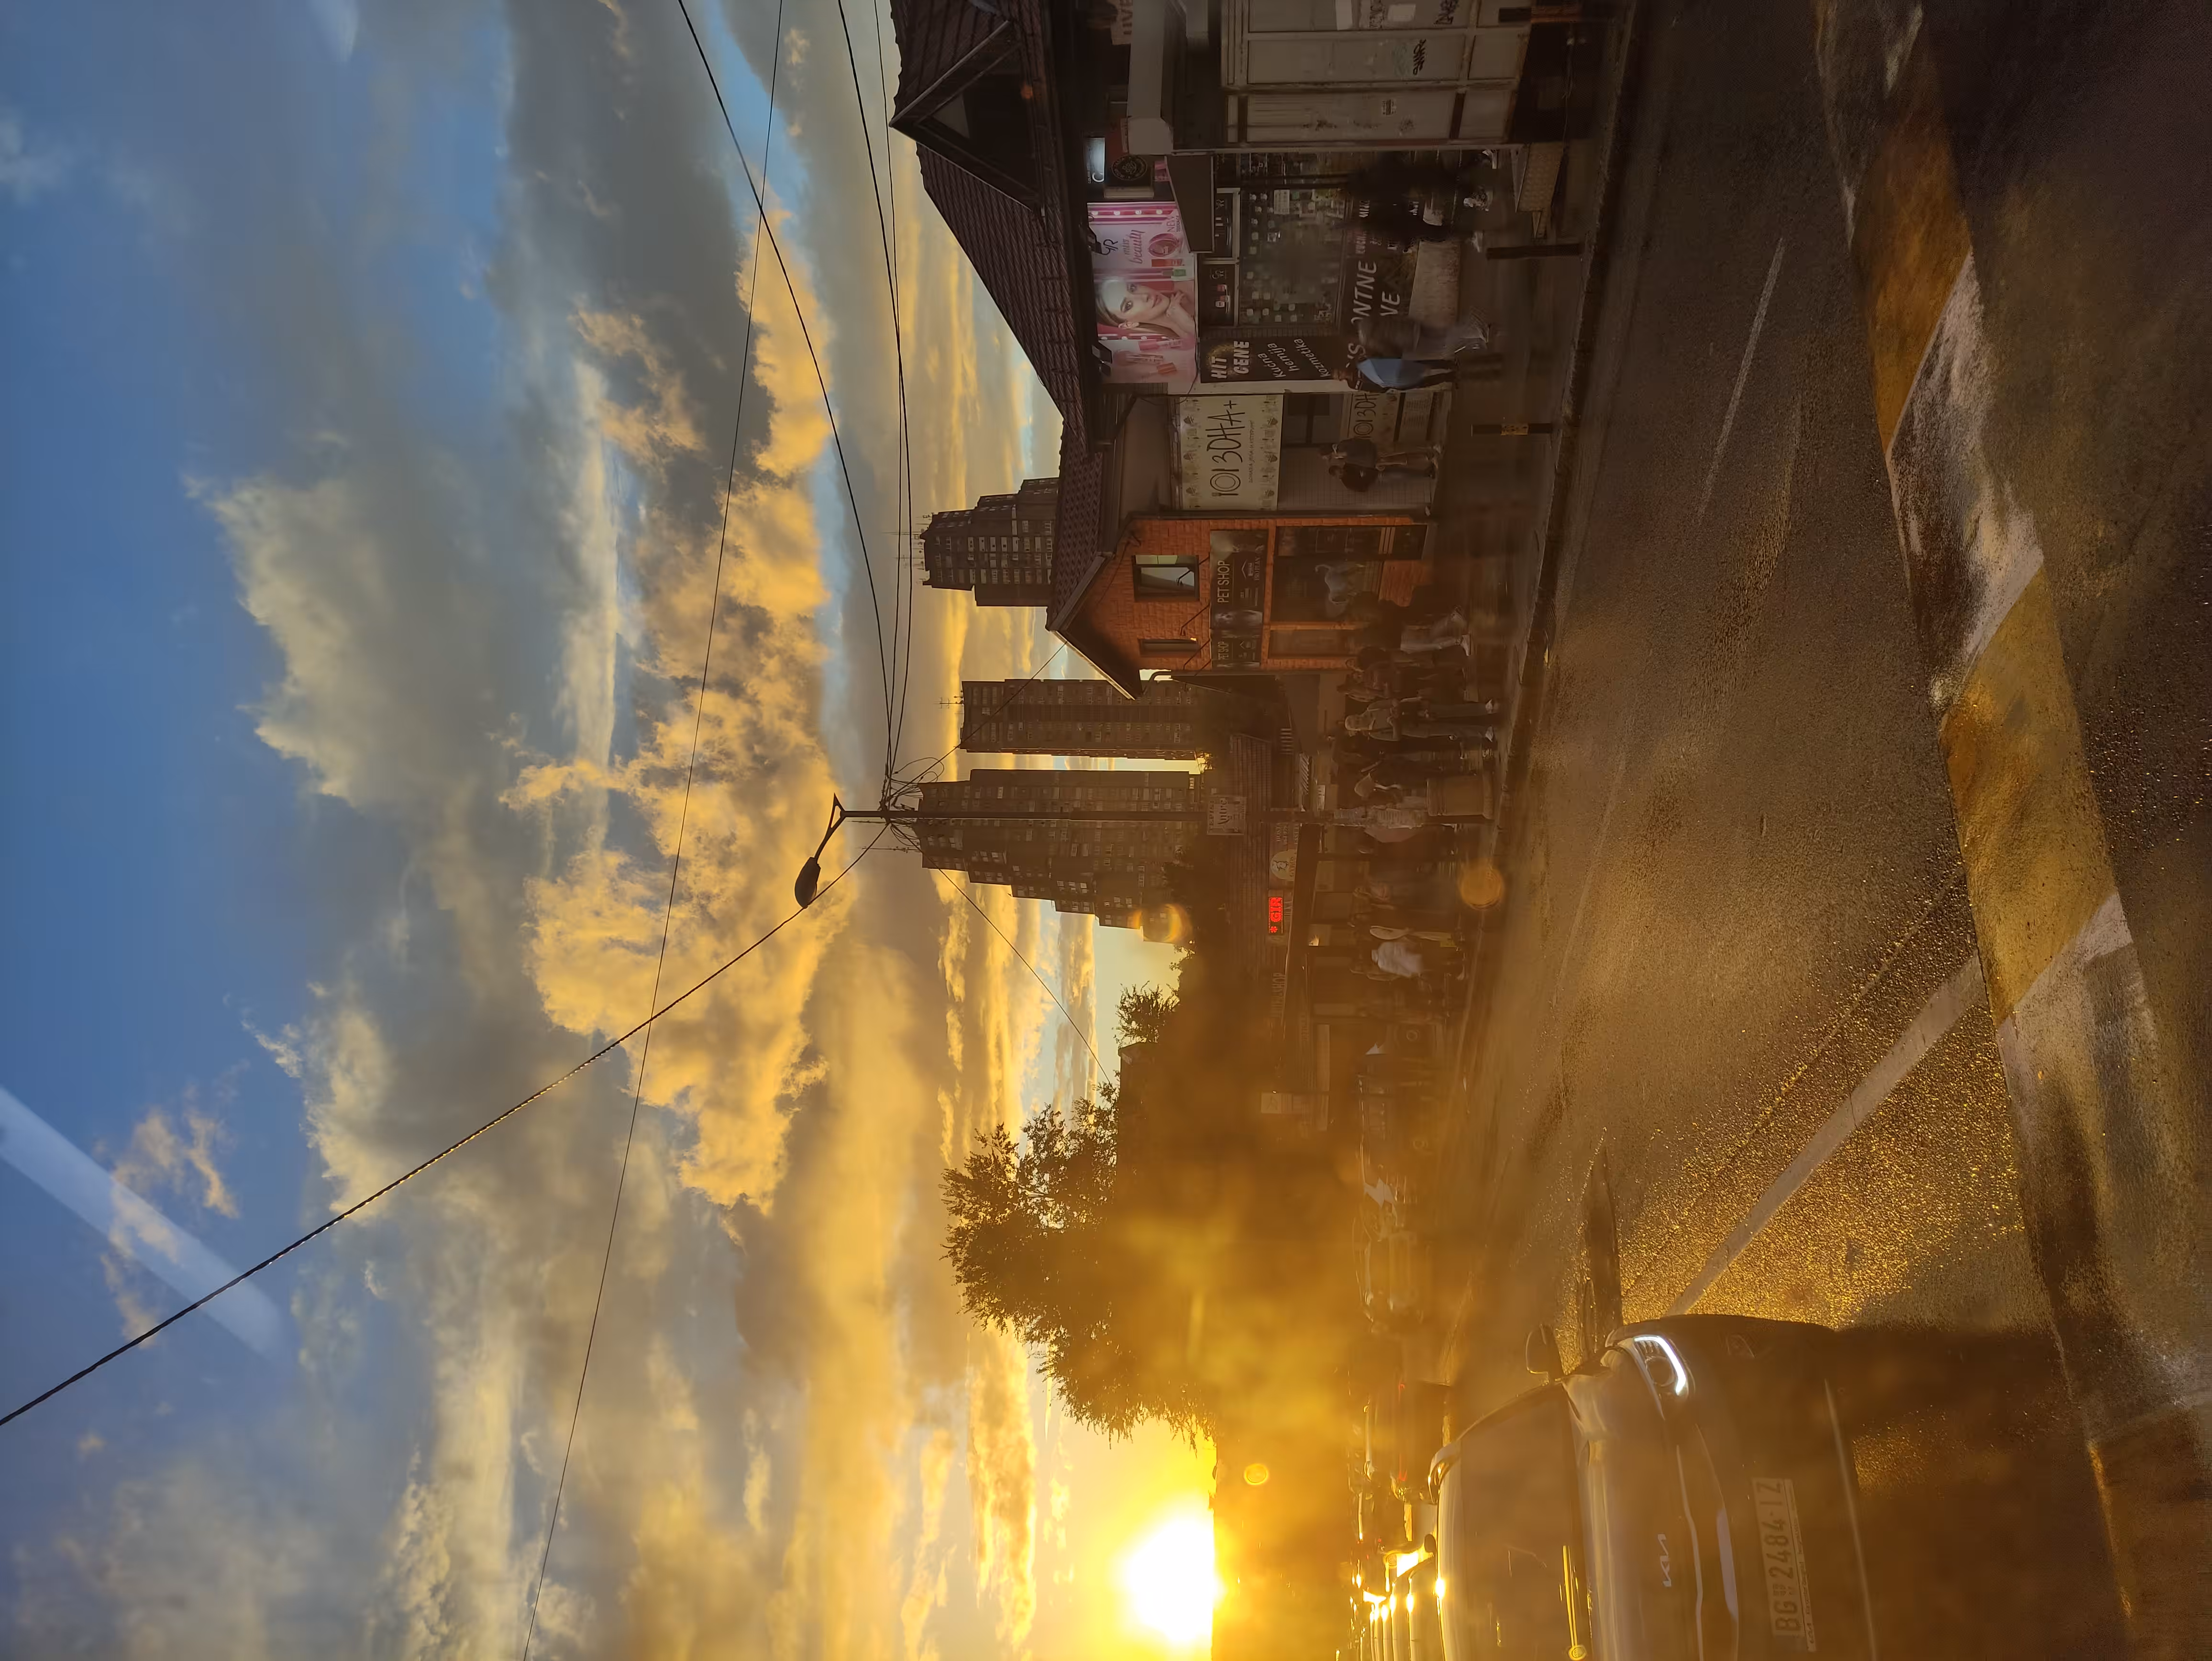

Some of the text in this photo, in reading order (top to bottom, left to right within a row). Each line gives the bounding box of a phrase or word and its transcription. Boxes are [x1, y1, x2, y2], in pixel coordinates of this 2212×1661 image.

[1128, 229, 1146, 264] beauty
[1211, 356, 1228, 379] HIT
[1268, 343, 1300, 372] hemija
[1294, 338, 1332, 377] kozmetika
[1217, 560, 1230, 603] PET SHOP
[1217, 641, 1229, 653] SHOP
[1773, 1600, 1801, 1630] BG
